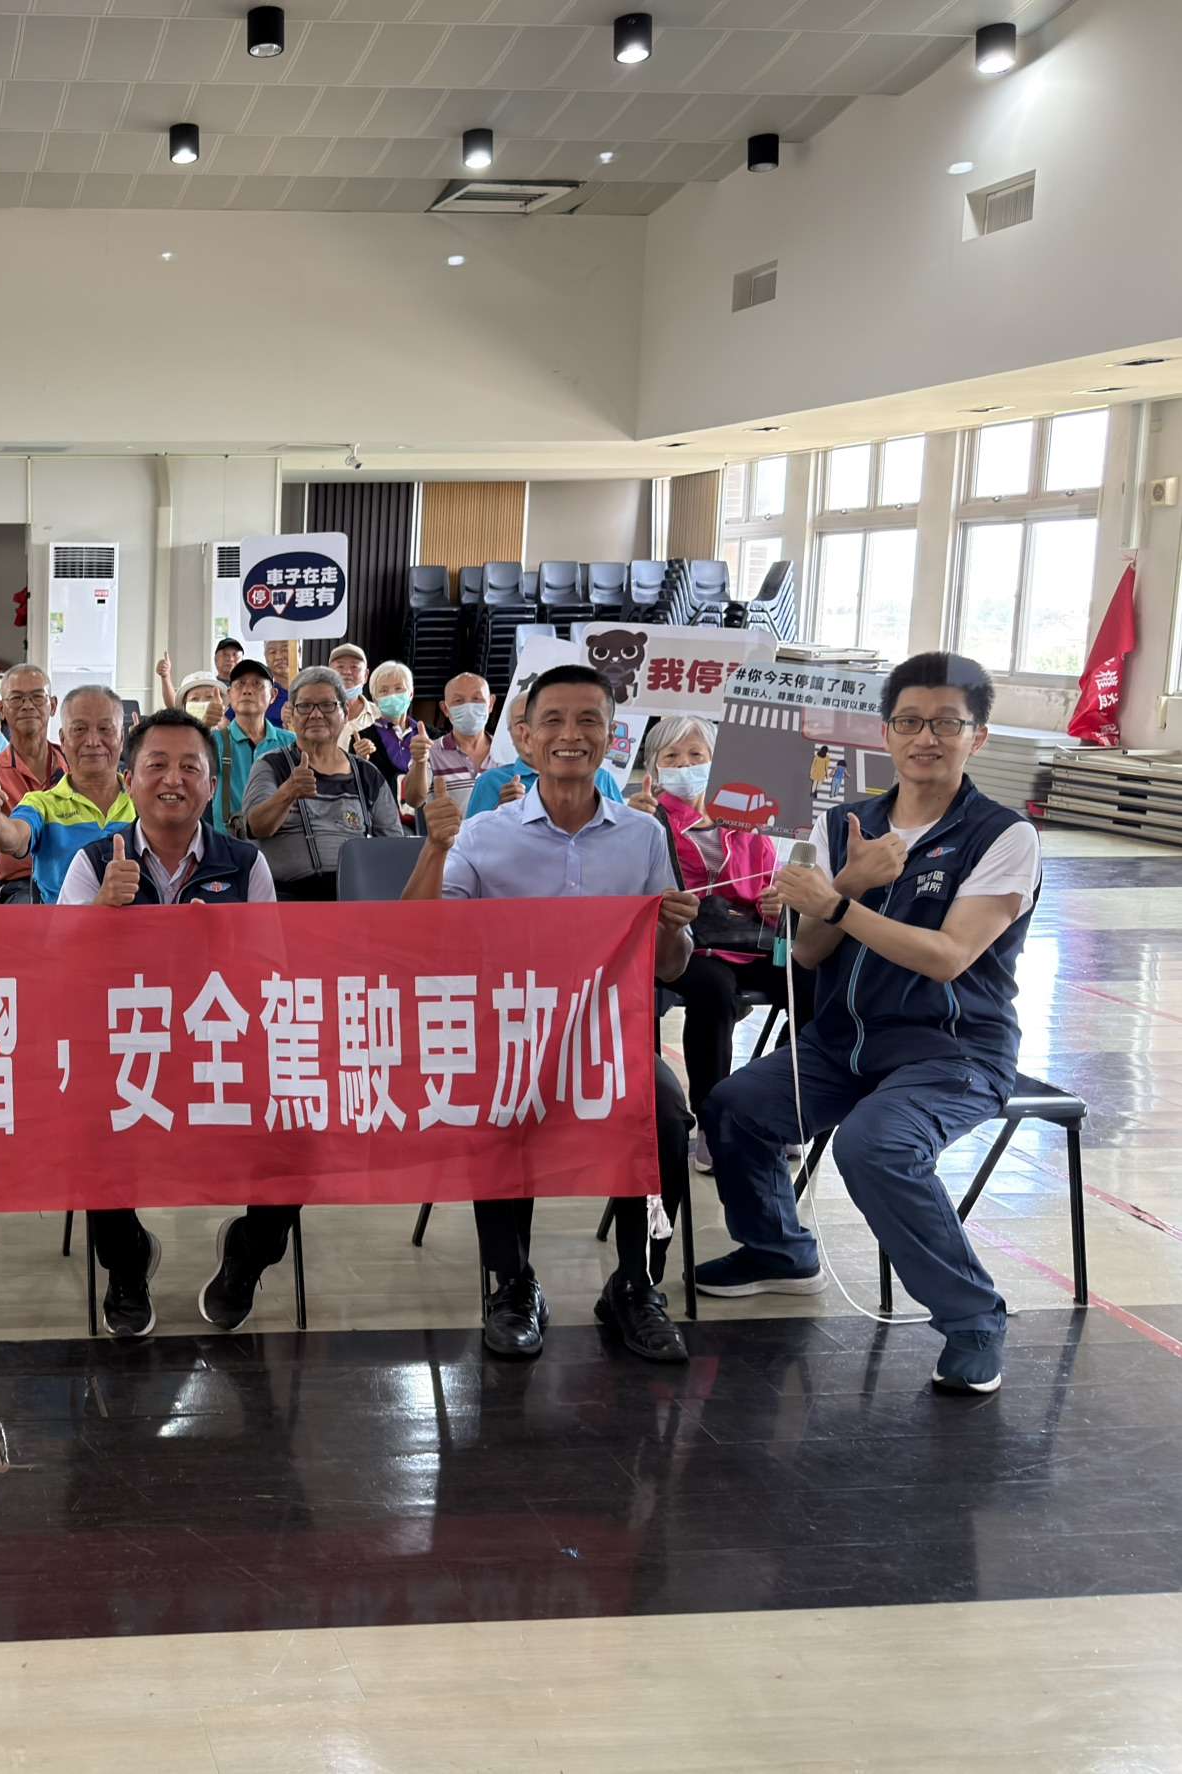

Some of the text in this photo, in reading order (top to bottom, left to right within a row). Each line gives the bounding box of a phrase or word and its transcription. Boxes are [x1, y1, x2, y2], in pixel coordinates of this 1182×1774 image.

[266, 567, 338, 586] 車子在走
[647, 658, 744, 695] 我停
